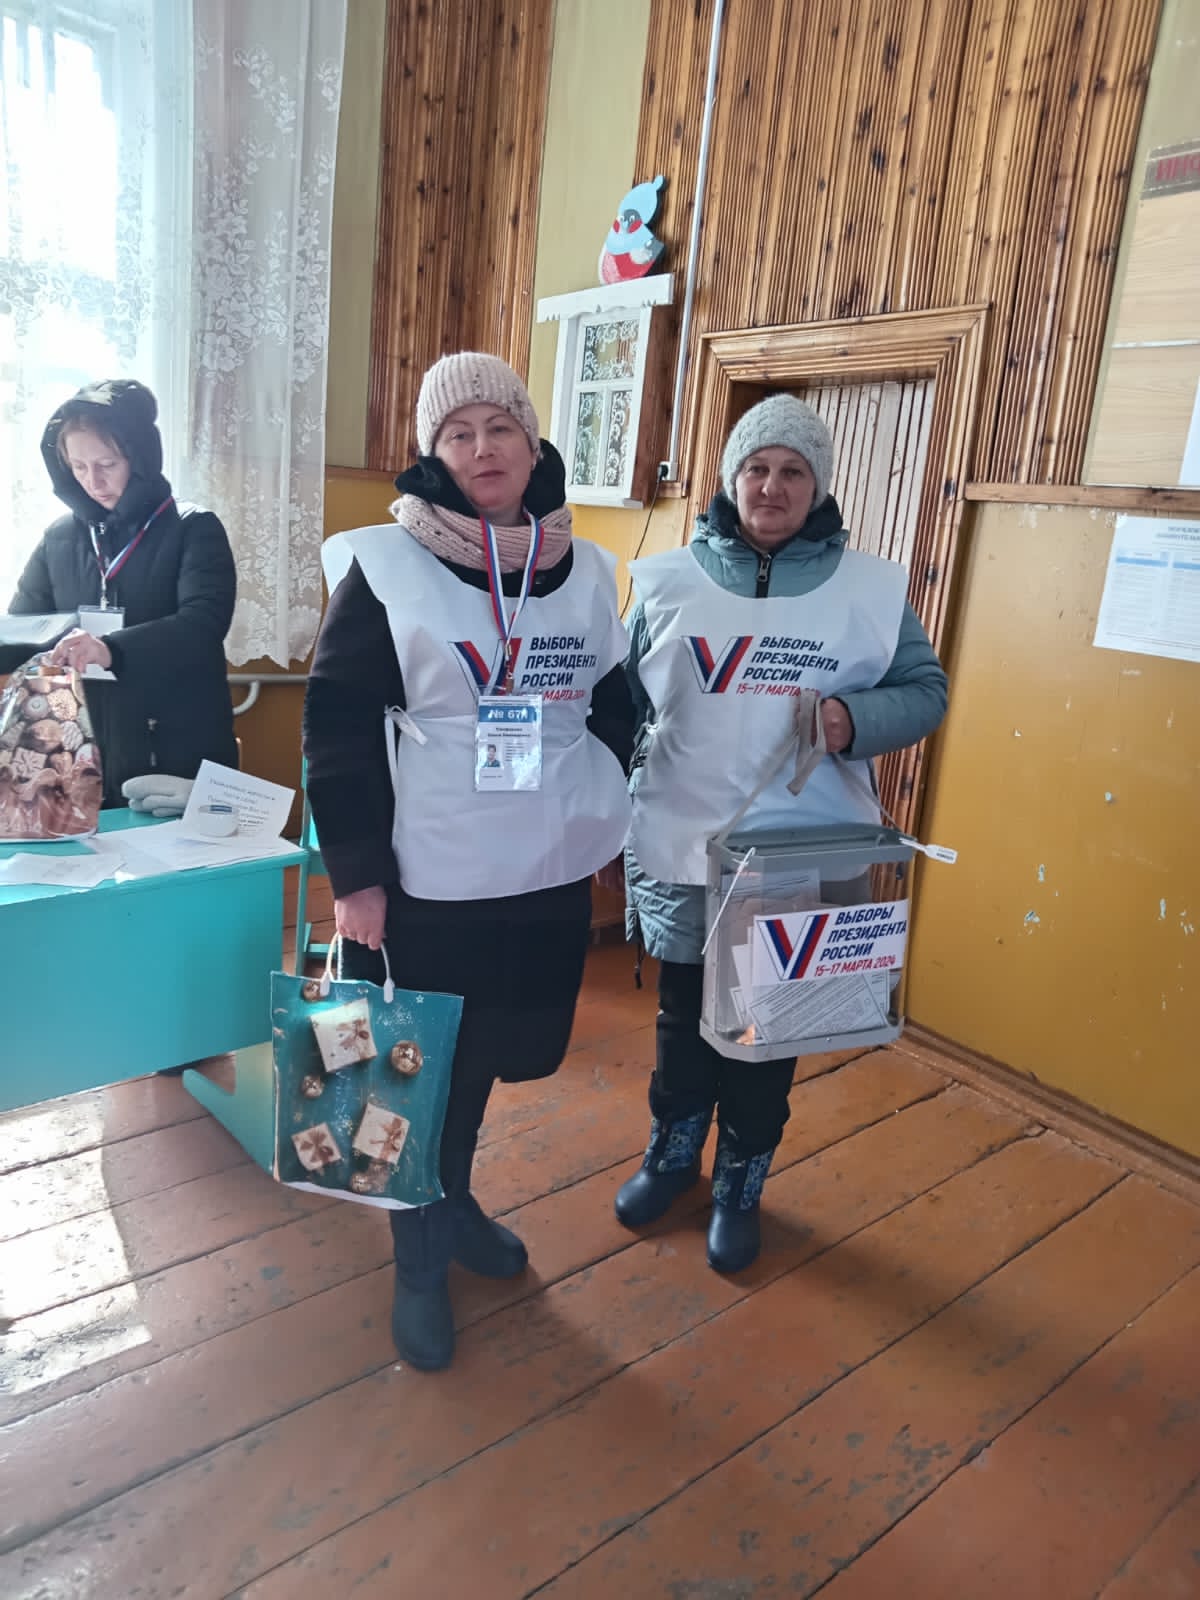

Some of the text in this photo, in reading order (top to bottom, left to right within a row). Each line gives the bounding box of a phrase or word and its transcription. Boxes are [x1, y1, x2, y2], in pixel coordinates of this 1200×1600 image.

[530, 636, 585, 650] ВЫБОРЫ
[759, 636, 824, 652] ВЫБОРЫ
[751, 651, 840, 672] ПРЕЗИДЕНТА
[520, 672, 574, 687] РОССИИ
[742, 667, 803, 682] РОССИИ
[765, 685, 801, 697] МАРТА
[835, 905, 895, 925] ВЫБОРЫ
[827, 919, 907, 943] ПРЕЗИДЕНТА
[819, 942, 875, 962] РОССИИ
[841, 958, 873, 973] МАРТА
[873, 954, 897, 969] 2024
